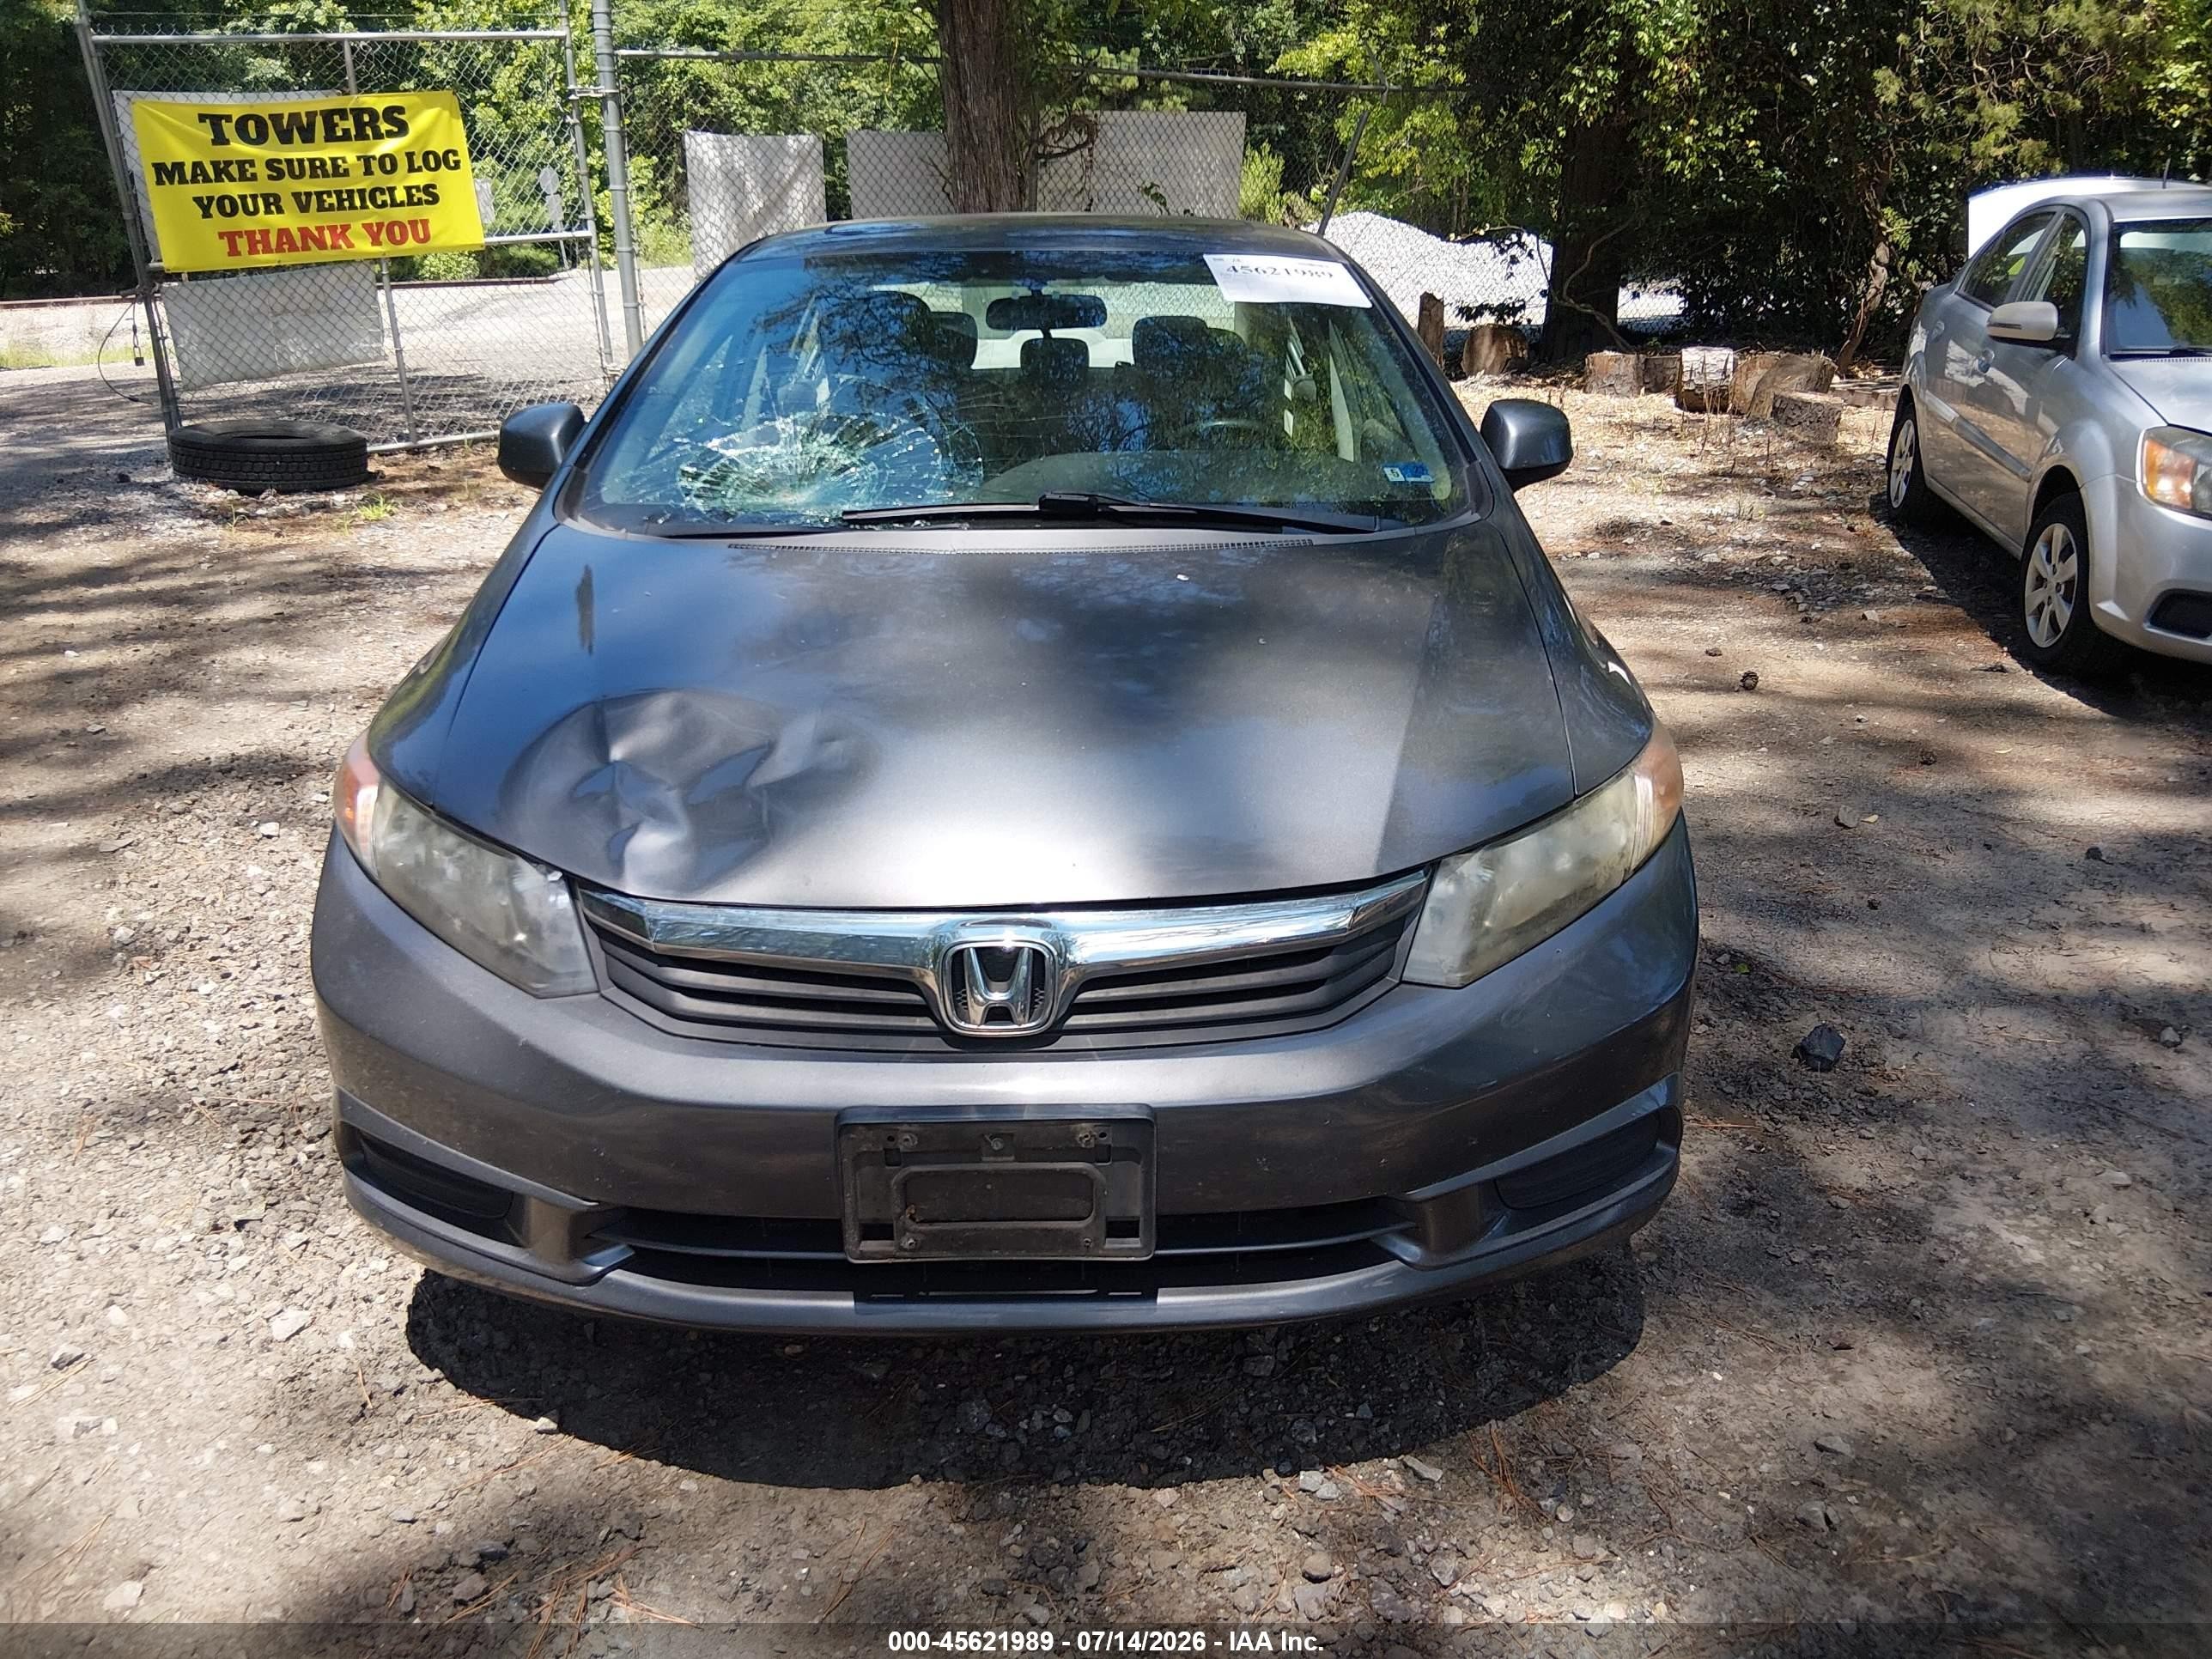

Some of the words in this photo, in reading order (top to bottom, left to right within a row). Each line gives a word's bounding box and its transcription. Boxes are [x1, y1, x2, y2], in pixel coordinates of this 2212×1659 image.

[198, 105, 410, 146] TOWERS
[151, 158, 258, 186] MAKE
[265, 155, 350, 181] SURE
[356, 152, 398, 177] TO
[405, 149, 461, 173] LOG
[192, 191, 285, 219] YOUR
[291, 183, 441, 214] VEHICLES
[217, 223, 355, 257] THANK
[362, 218, 432, 246] YOU
